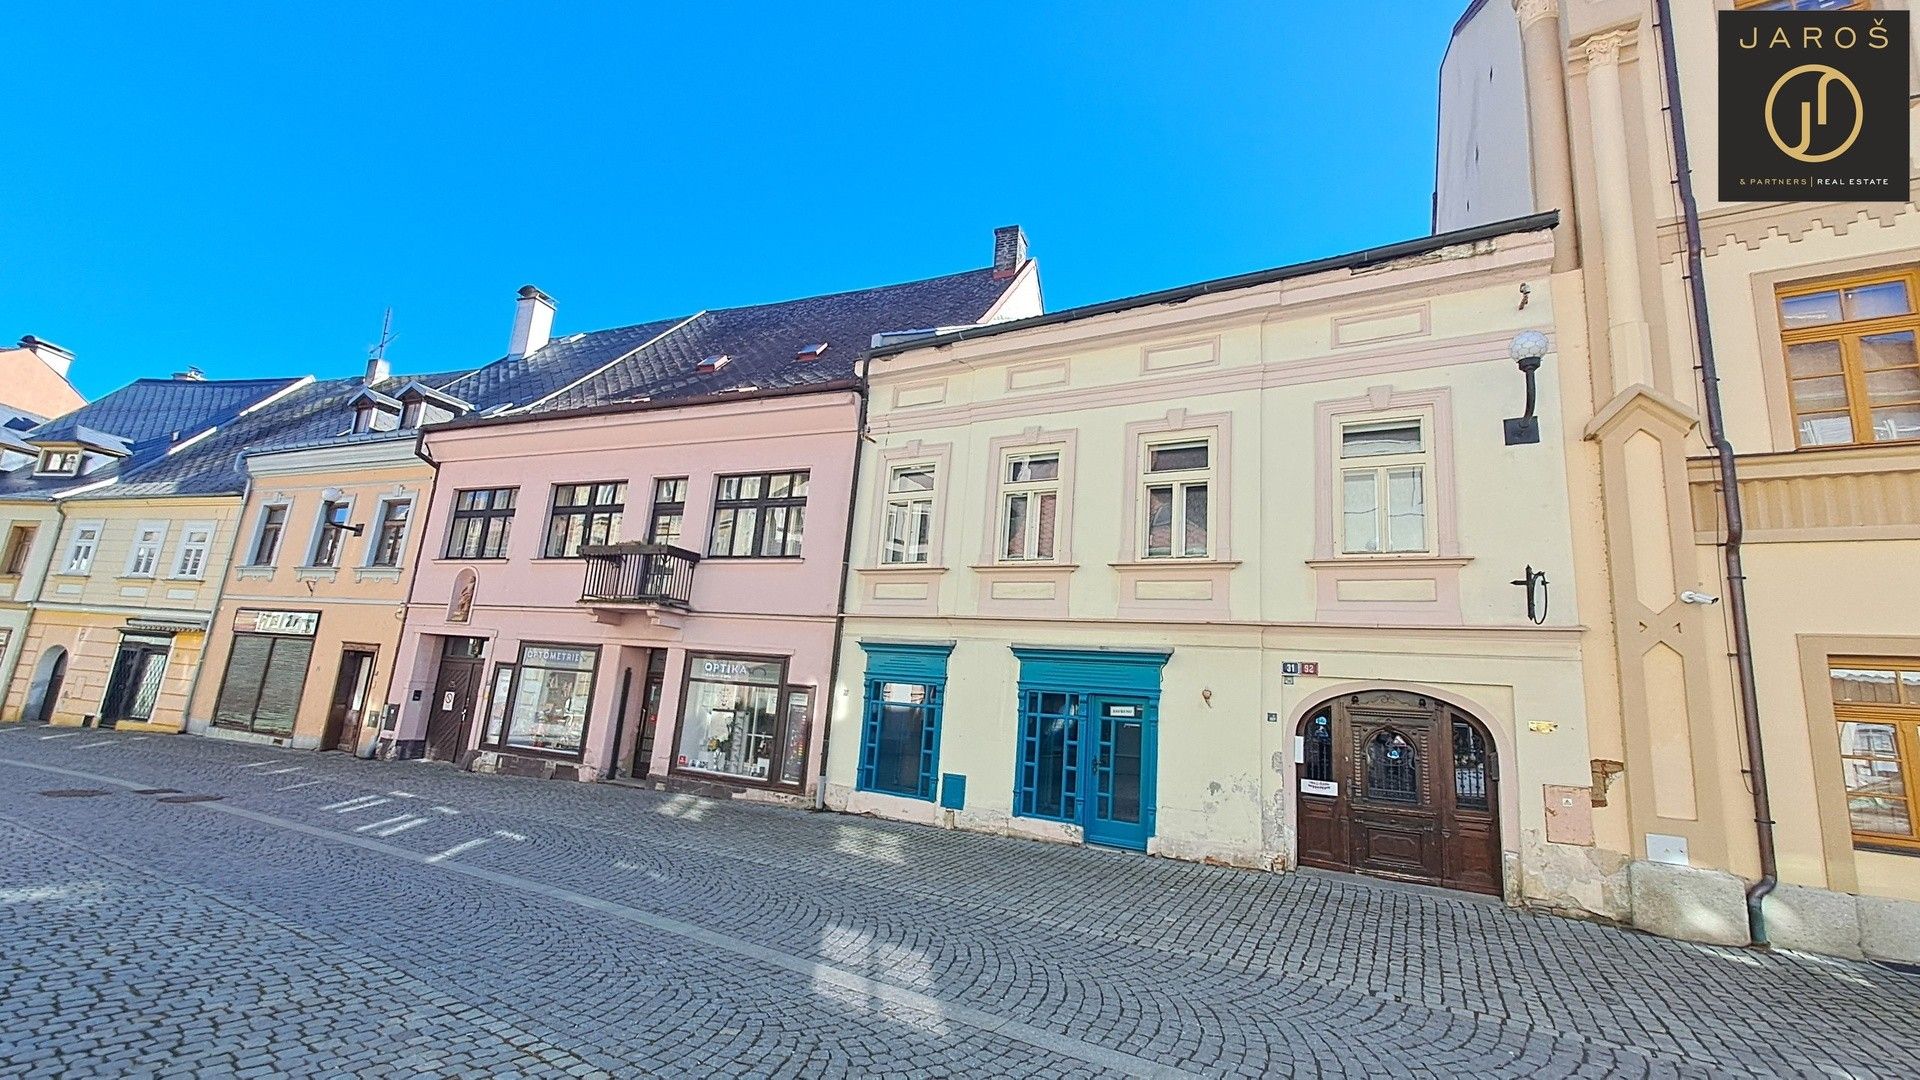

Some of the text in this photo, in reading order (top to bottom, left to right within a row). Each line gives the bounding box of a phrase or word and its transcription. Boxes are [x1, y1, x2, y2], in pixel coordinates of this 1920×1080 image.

[527, 650, 580, 662] OPTOMETRIE
[704, 661, 747, 675] OPTIKA
[1286, 663, 1295, 672] 31
[1304, 664, 1314, 673] 92
